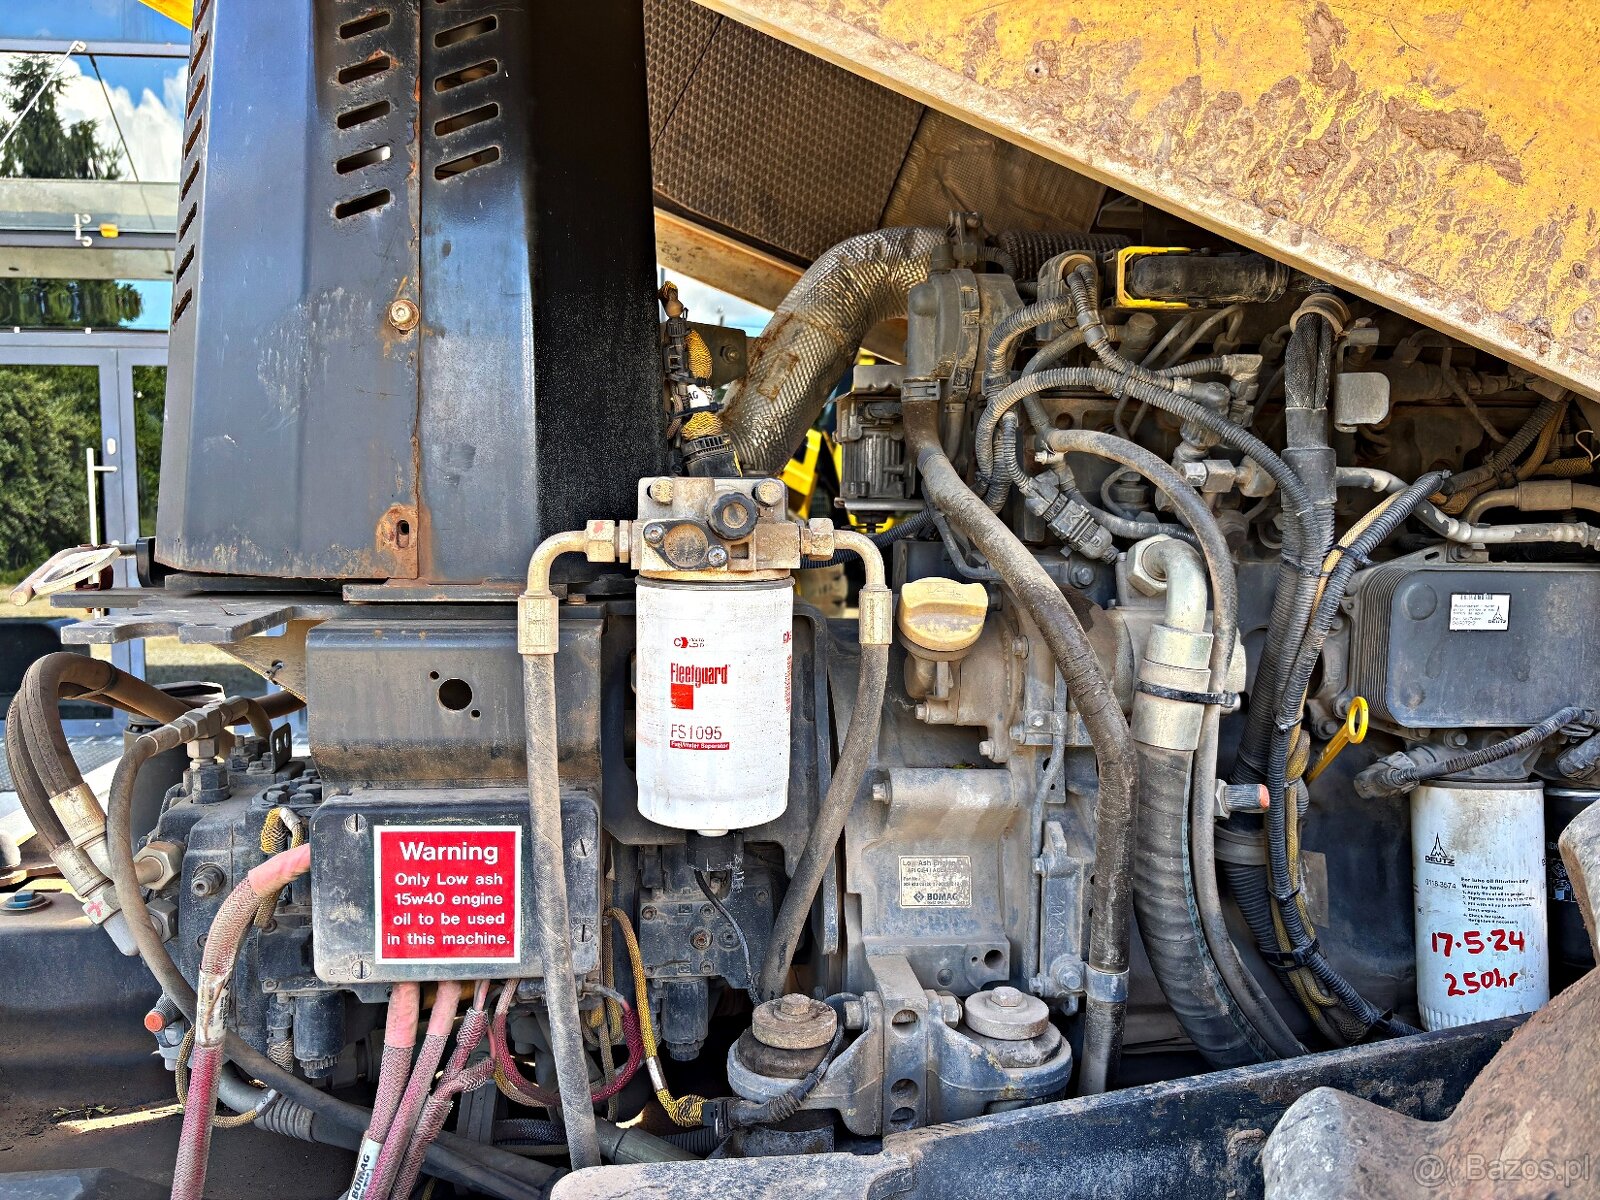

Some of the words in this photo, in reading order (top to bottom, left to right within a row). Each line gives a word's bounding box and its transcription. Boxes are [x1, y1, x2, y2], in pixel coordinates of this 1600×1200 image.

[670, 662, 728, 688] Fleetguard
[670, 724, 722, 740] FS1095
[400, 842, 498, 865] Warning
[1425, 856, 1455, 864] DEUTZ
[394, 873, 430, 887] Only
[437, 873, 468, 885] Low
[475, 873, 503, 885] ash
[394, 892, 445, 906] 15w40
[452, 893, 503, 907] engine
[393, 913, 411, 926] oil
[418, 914, 434, 926] to
[440, 913, 460, 925] be
[468, 912, 505, 925] used
[387, 933, 400, 945] in
[407, 933, 435, 945] this
[443, 932, 510, 945] machine.
[1444, 968, 1518, 996] 250hr
